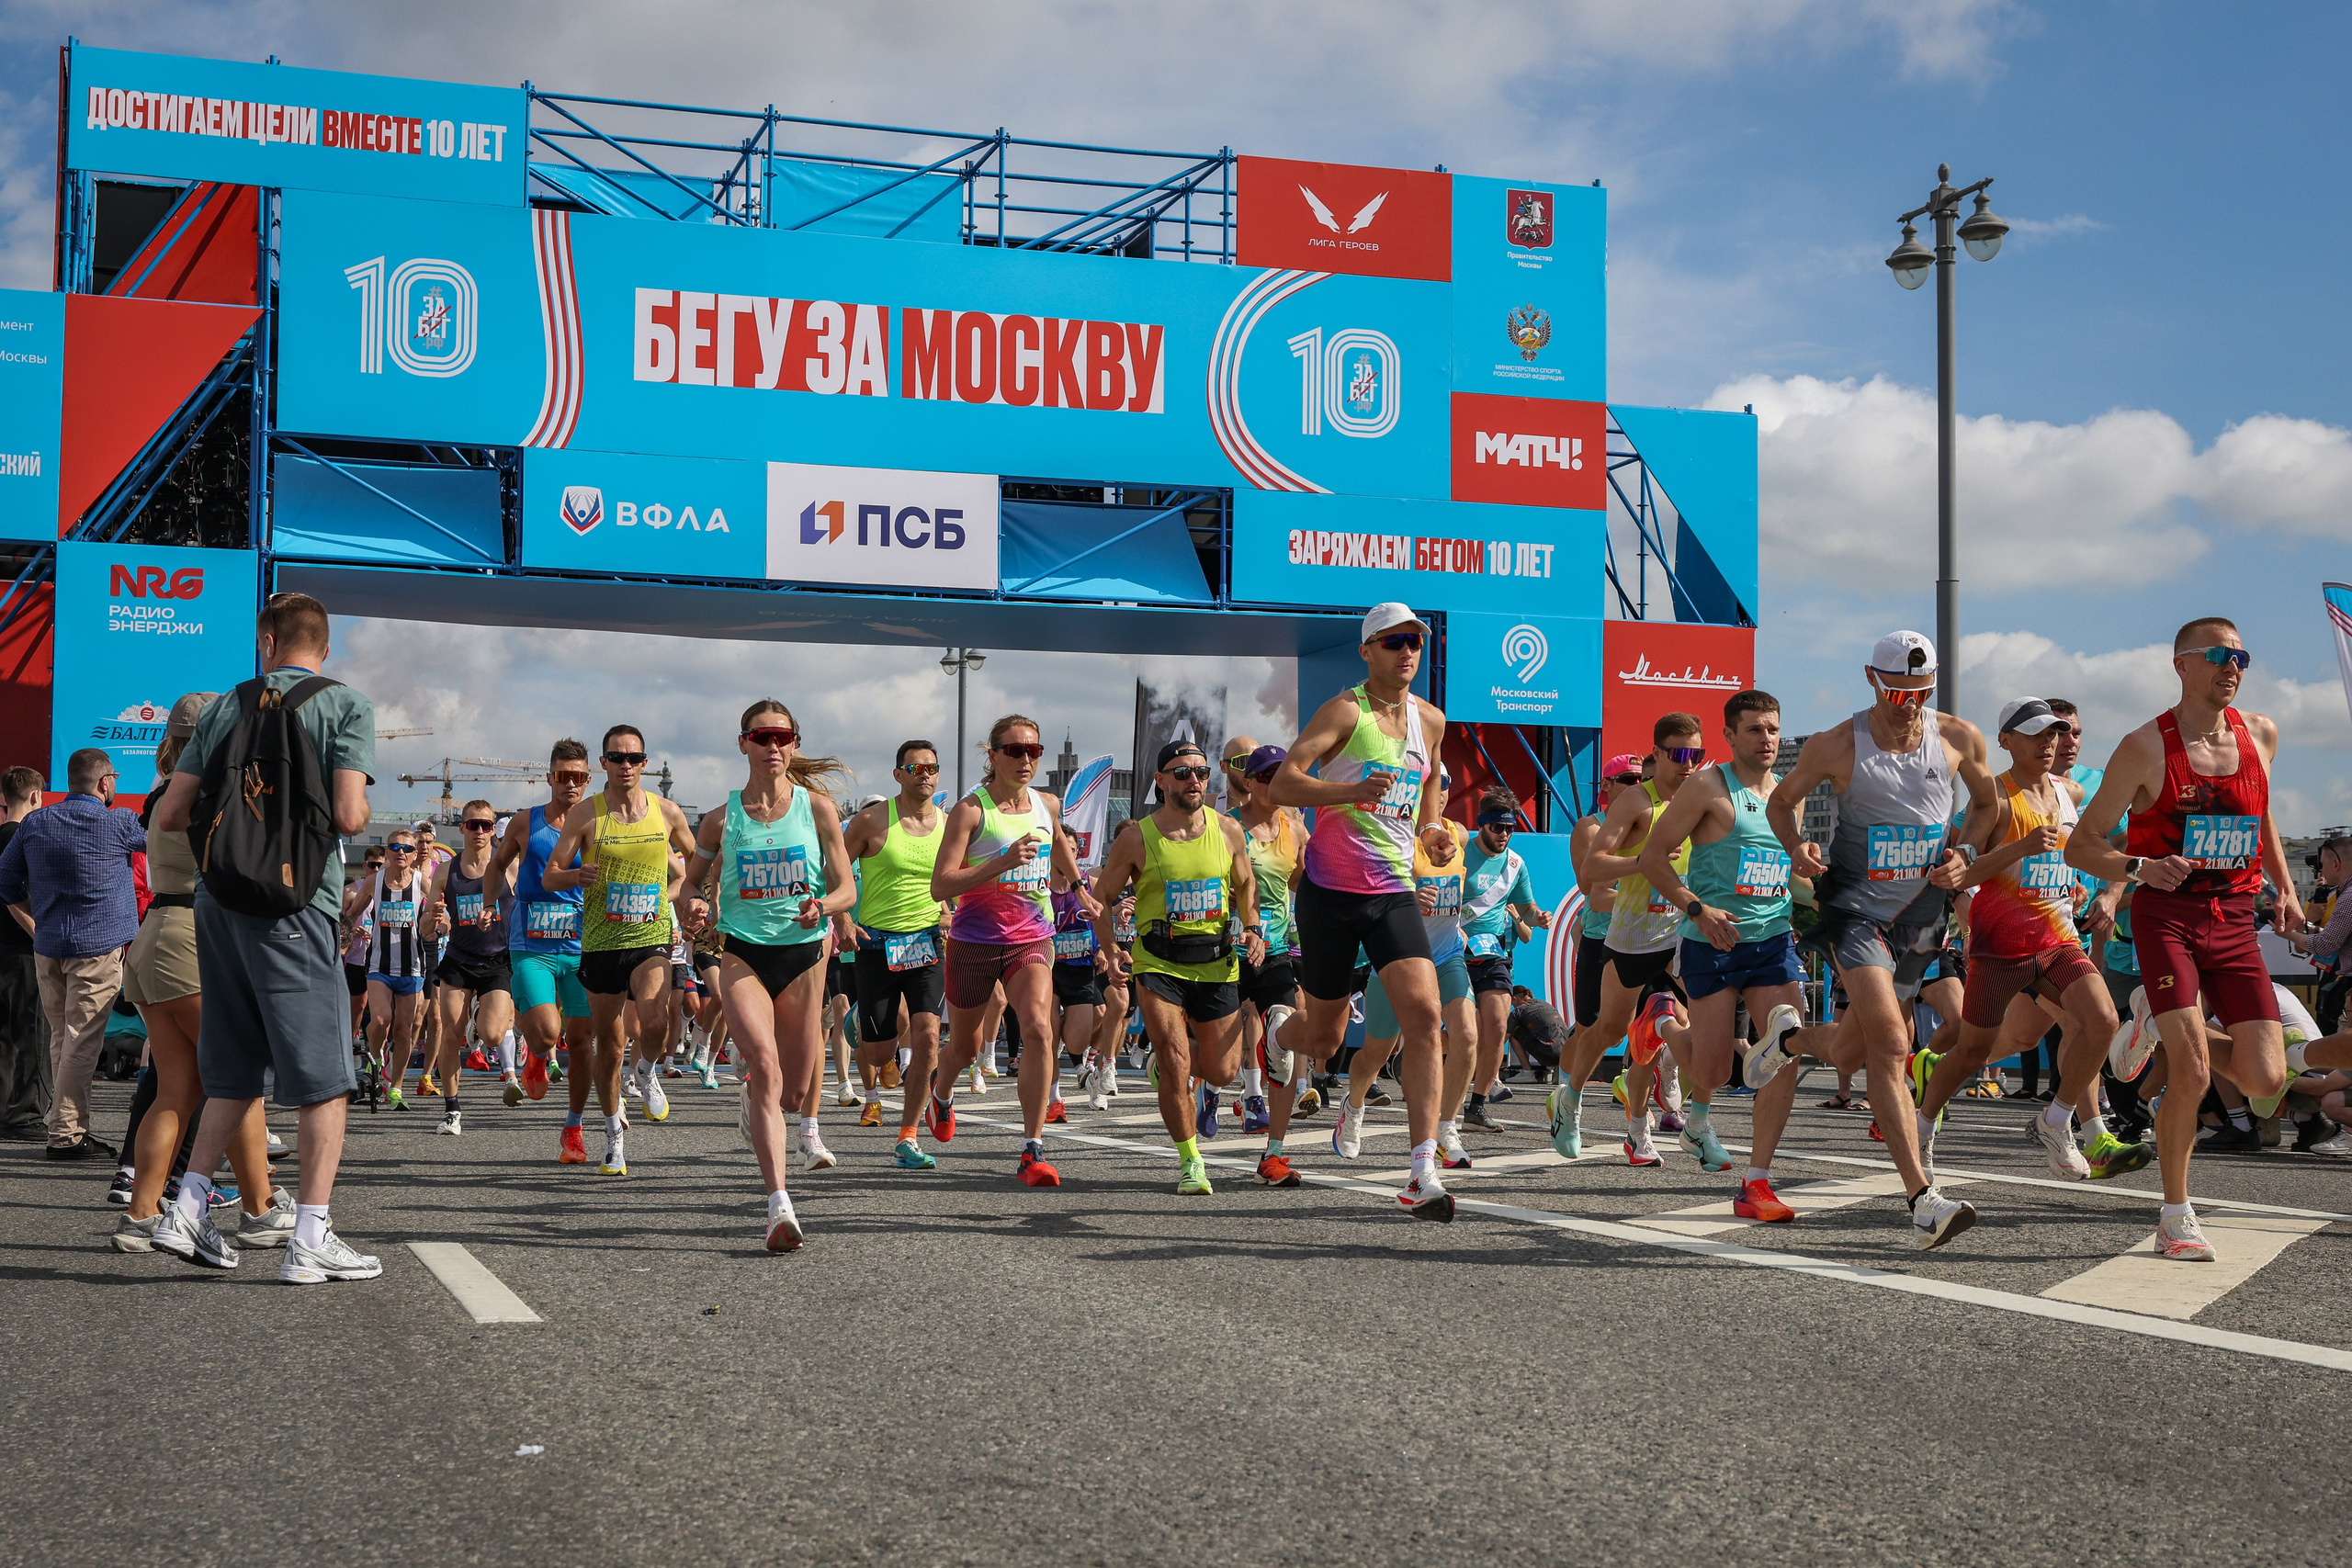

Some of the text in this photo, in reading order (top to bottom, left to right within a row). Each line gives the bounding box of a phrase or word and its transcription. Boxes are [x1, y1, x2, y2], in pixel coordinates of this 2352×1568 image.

[87, 86, 507, 162] ДОСТИГАЕМ ЦЕЛИ ВМЕСТЕ 10 ЛЕТ
[1308, 238, 1379, 251] ЛИГА ГЕРОЕВ
[1507, 251, 1553, 262] Правительство
[1518, 261, 1542, 269] Москвы
[344, 254, 479, 378] 10
[0, 321, 34, 332] мент
[634, 287, 1164, 414] БЕГУ ЗА МОСКВУ
[1493, 370, 1565, 381] РОССИЙСКОЙ ФЕДЕРАЦИИ
[1495, 364, 1562, 375] МИНИСТЕРСТВО СПОРТА
[1287, 326, 1401, 438] 10
[1476, 431, 1583, 470] МАТЧ!
[616, 502, 730, 533] ВФЛА
[858, 503, 967, 549] ПСБ
[1288, 529, 1555, 578] ЗАРЯЖАЕМ БЕГОМ 10 ЛЕТ
[109, 564, 204, 600] NRG
[108, 604, 175, 620] РАДИО
[108, 620, 203, 636] ЭНЕРДЖИ
[1618, 652, 1742, 687] Москвич
[1490, 685, 1559, 699] Московский
[1496, 699, 1553, 715] Транспорт
[109, 725, 168, 741] БАЛТ
[1385, 780, 1417, 806] 082
[2193, 830, 2252, 855] 74781
[1874, 839, 1939, 867] 75697
[2233, 856, 2246, 869] A
[742, 859, 805, 887] 75700
[1743, 862, 1787, 886] 75504
[2029, 863, 2073, 886] 75701
[791, 882, 804, 895] A
[1039, 878, 1046, 889] A
[1773, 885, 1781, 897] A
[2060, 886, 2069, 897] A
[611, 893, 655, 913] 74352
[1171, 889, 1217, 911] 76815
[1434, 886, 1457, 907] 138
[381, 909, 413, 921] 70632
[459, 902, 484, 919] 740
[646, 912, 654, 921] A
[533, 912, 574, 930] 74772
[888, 942, 933, 963] 76283
[1057, 937, 1091, 953] 76364
